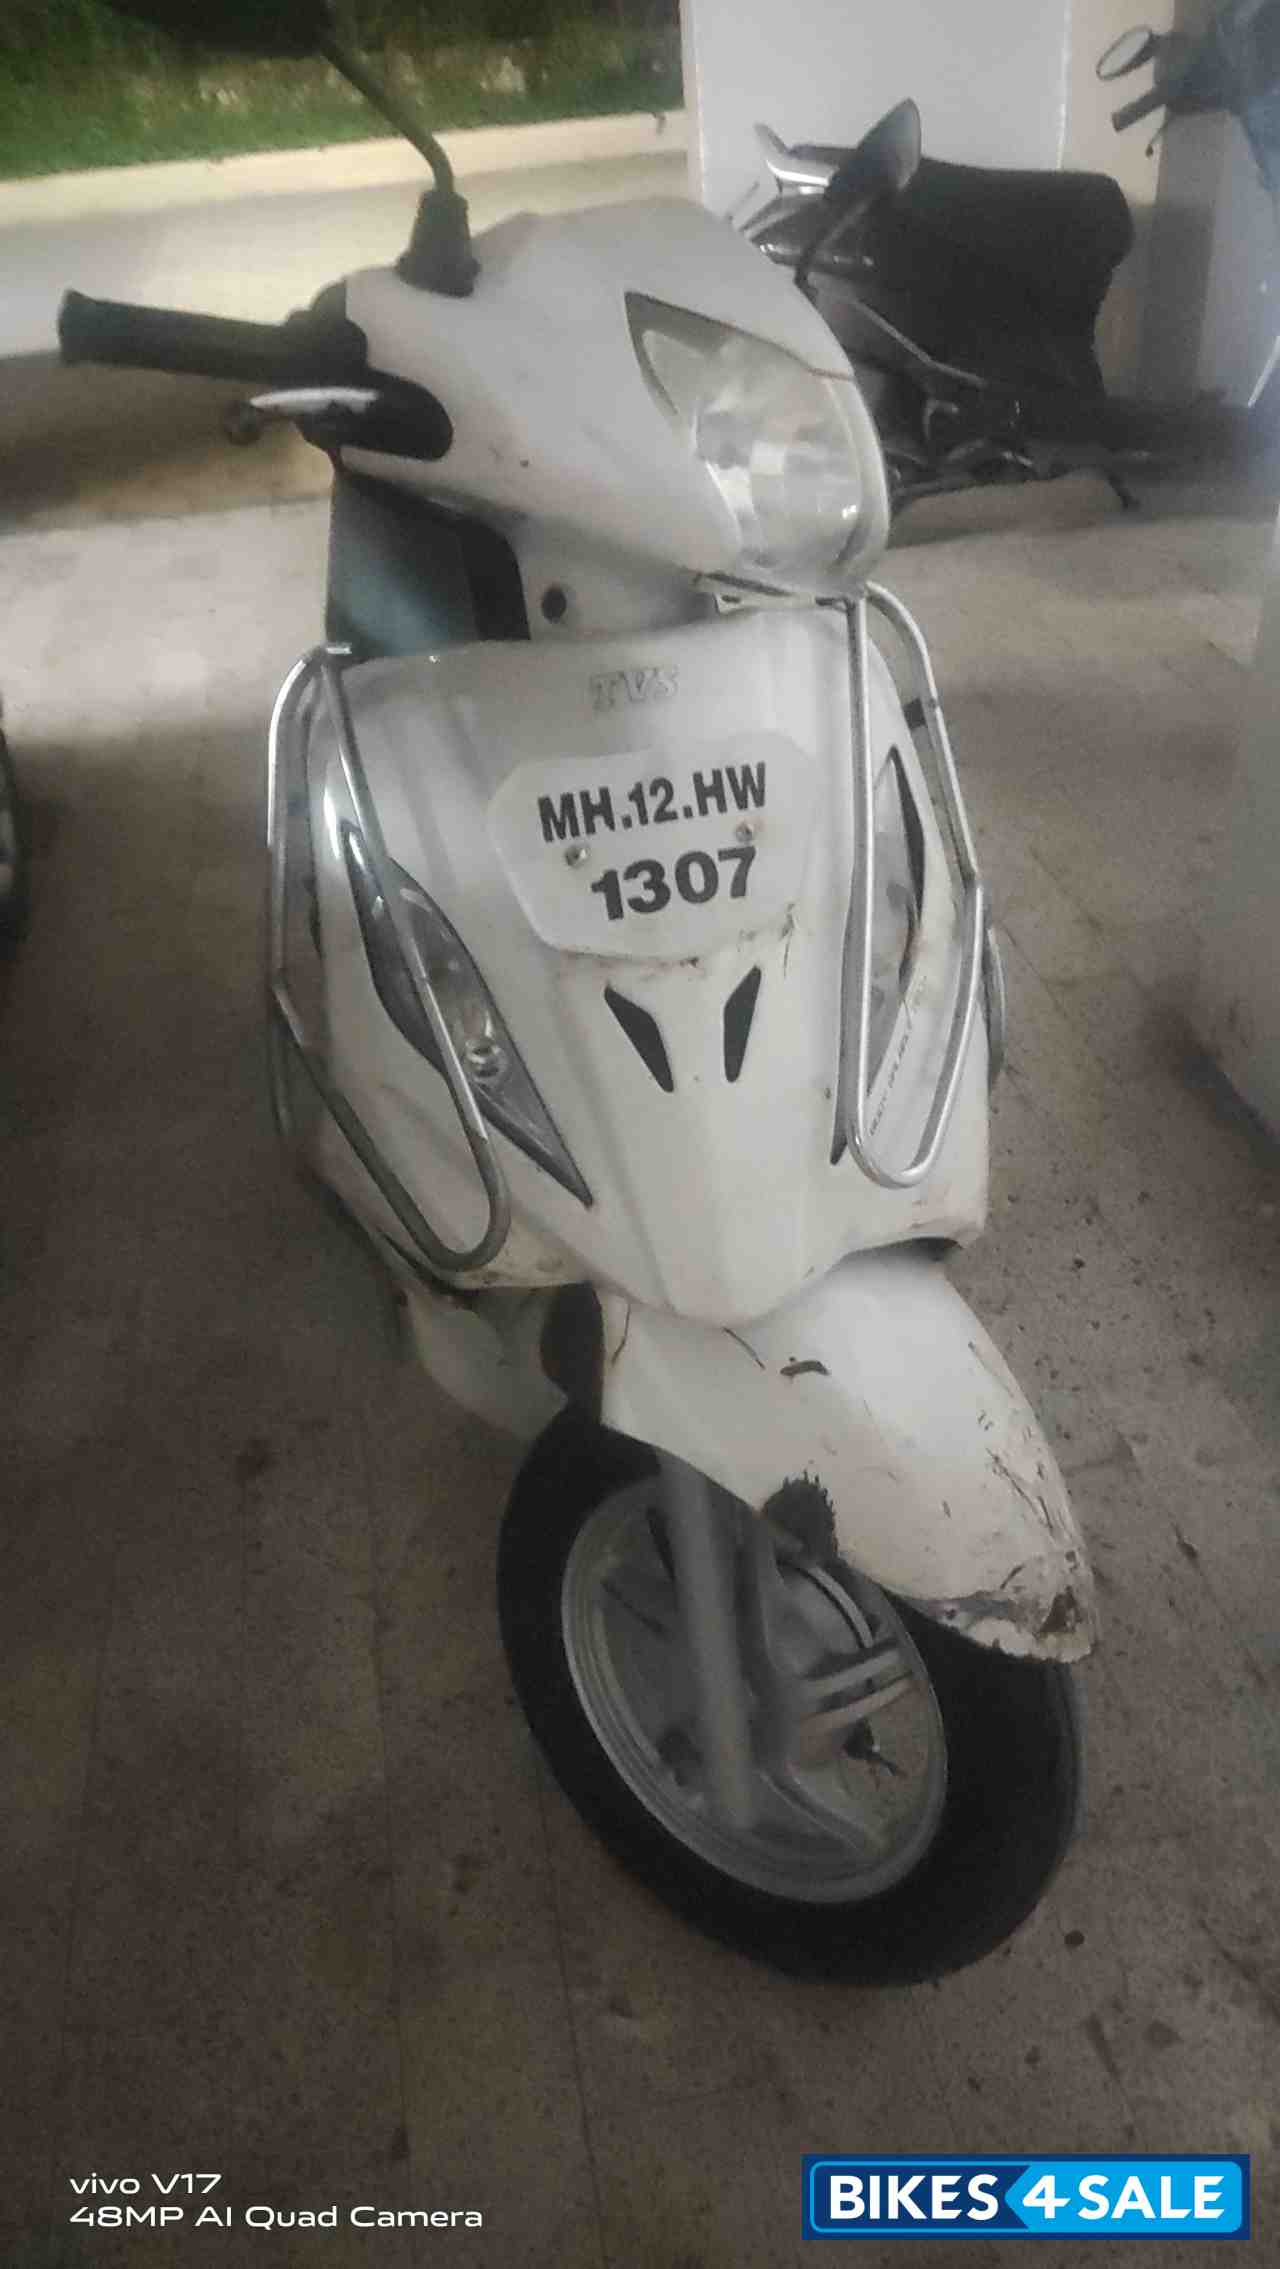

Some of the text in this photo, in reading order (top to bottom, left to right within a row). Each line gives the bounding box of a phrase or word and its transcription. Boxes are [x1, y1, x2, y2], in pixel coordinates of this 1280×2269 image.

[589, 664, 679, 711] TVS
[537, 762, 766, 843] MH.12.HW
[590, 846, 756, 921] 1307
